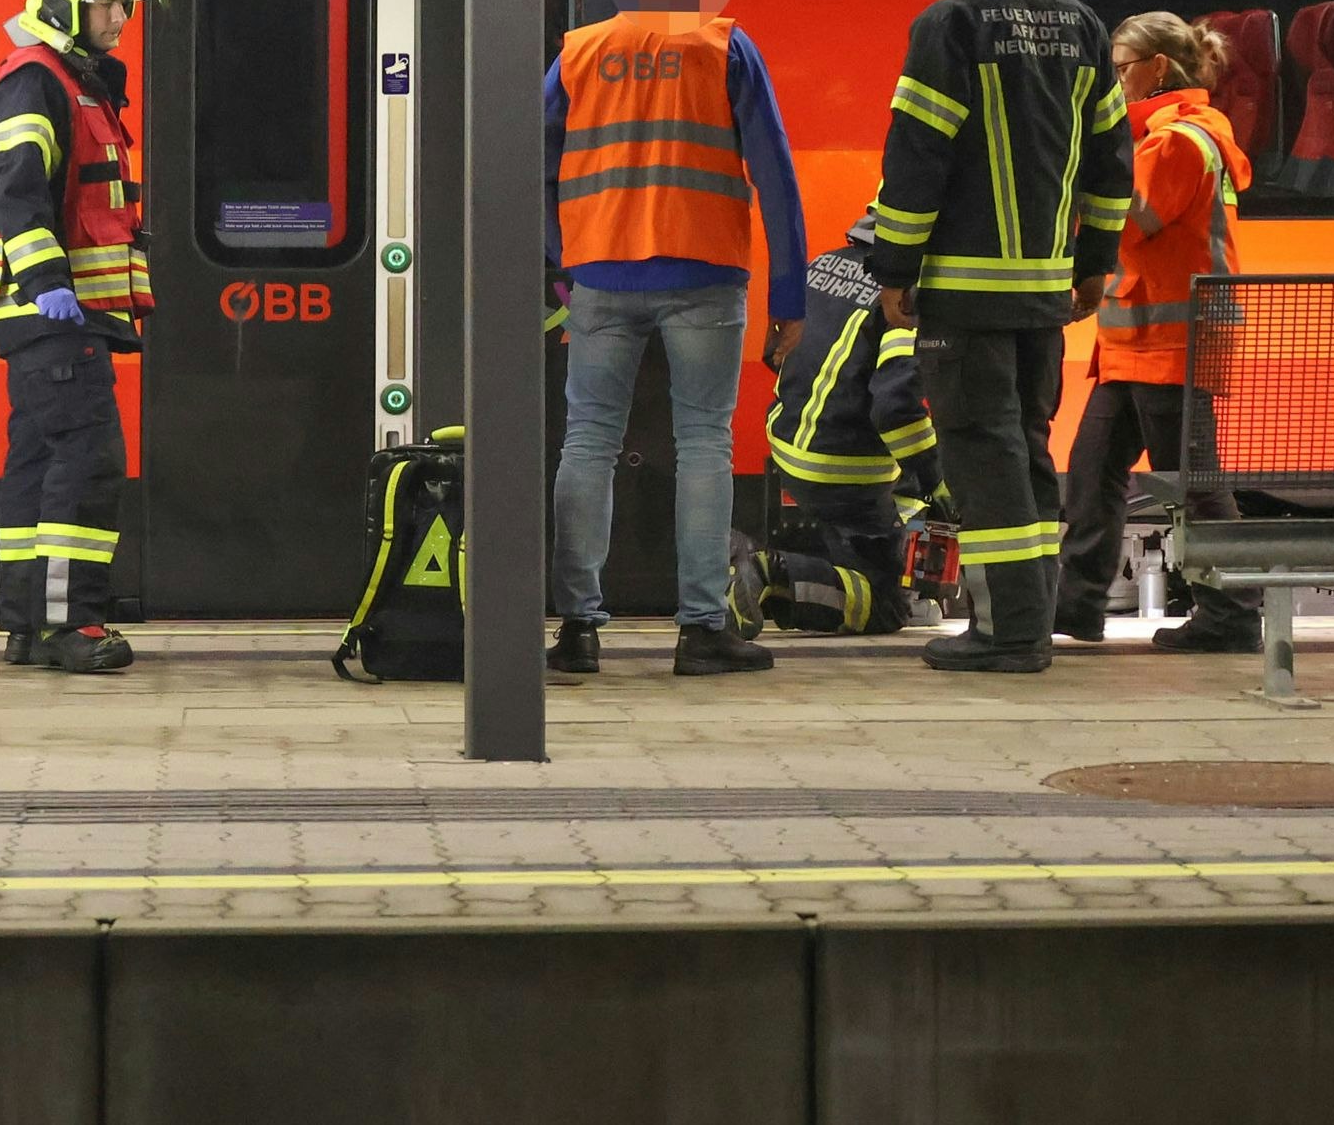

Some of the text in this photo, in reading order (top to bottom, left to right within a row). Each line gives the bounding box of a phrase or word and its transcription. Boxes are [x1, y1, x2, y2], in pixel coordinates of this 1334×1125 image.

[980, 8, 1081, 25] FEUERWEHR
[994, 40, 1080, 58] NEUHOFEN
[599, 49, 683, 83] ÖBB
[219, 280, 331, 322] ÖBB
